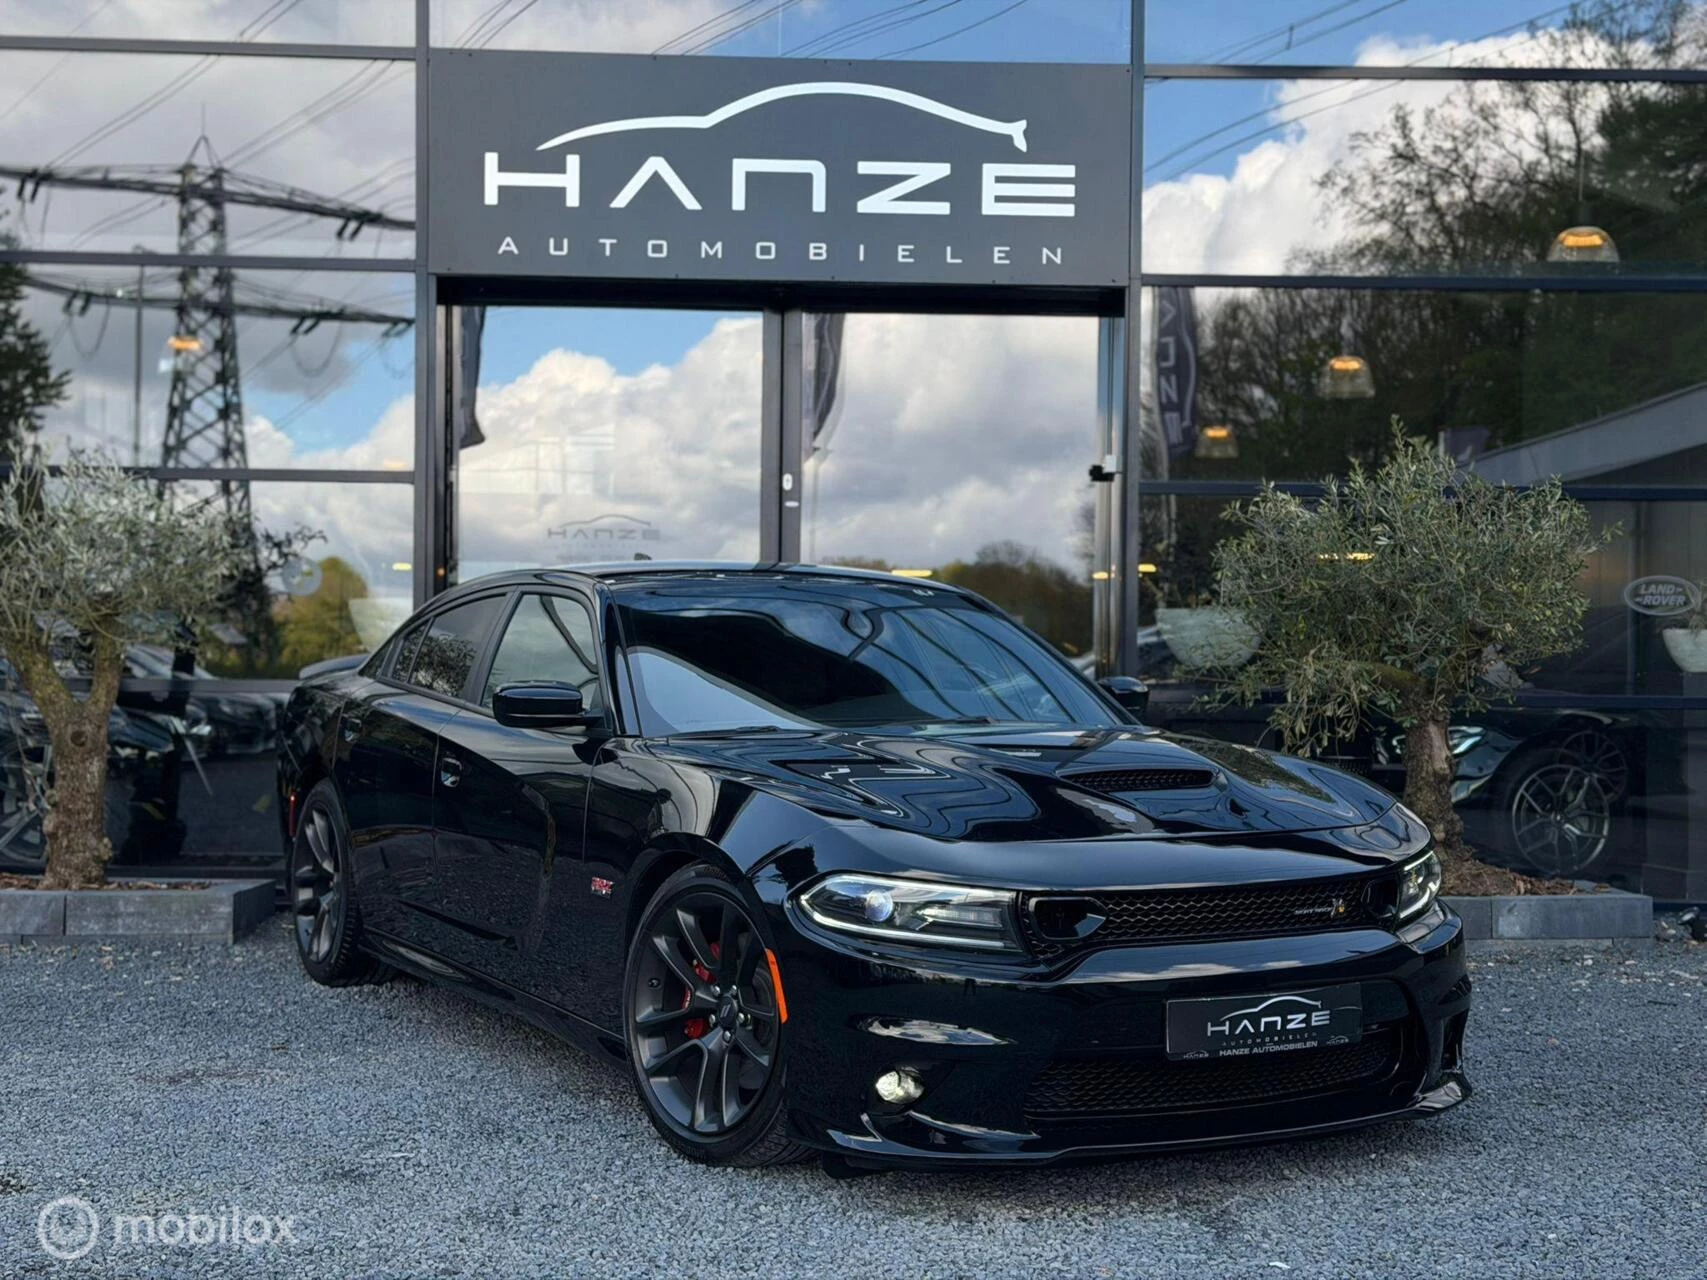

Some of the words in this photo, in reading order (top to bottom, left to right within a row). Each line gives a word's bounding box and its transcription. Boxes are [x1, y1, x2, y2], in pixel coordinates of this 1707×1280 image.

[485, 149, 1076, 217] HANZE
[498, 236, 1062, 266] AUTOMOBIELEN
[547, 528, 661, 541] HANZE
[1640, 584, 1676, 594] LAND
[1643, 595, 1686, 605] ROVER
[1207, 1010, 1331, 1037] HANZE
[1219, 1048, 1250, 1056] HANZE
[1252, 1041, 1318, 1054] AUTOMOBIELEN
